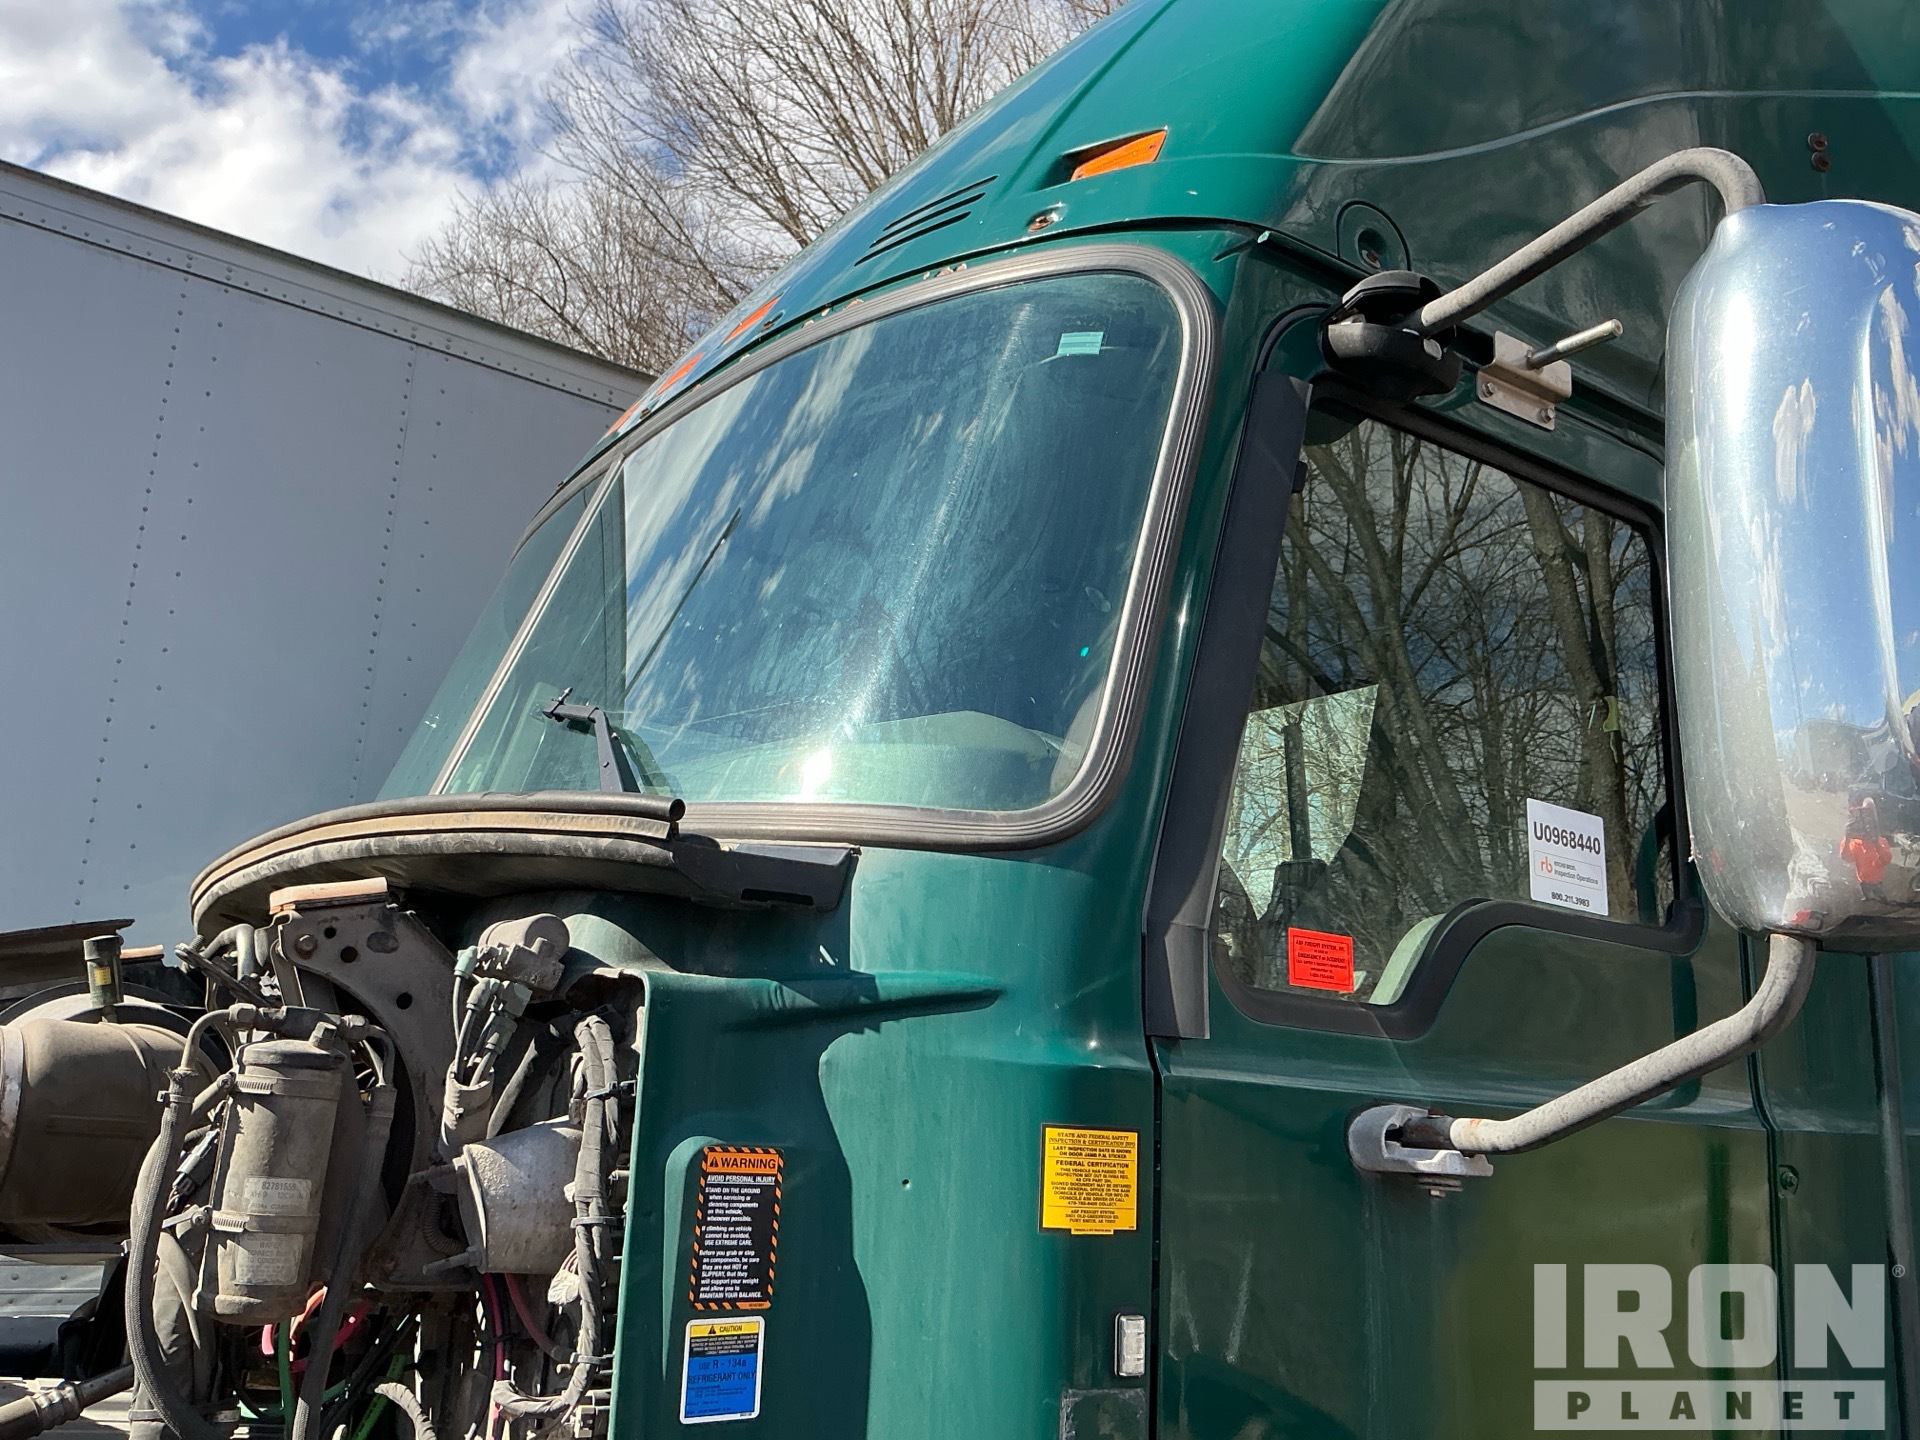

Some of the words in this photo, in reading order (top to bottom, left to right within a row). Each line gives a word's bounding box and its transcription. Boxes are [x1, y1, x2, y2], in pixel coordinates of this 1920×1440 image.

[1534, 821, 1600, 854] U0968440
[1555, 870, 1575, 879] Inspection
[1576, 874, 1598, 884] Operations
[721, 1157, 776, 1169] WARNING
[688, 1372, 736, 1384] REFRIGERANT
